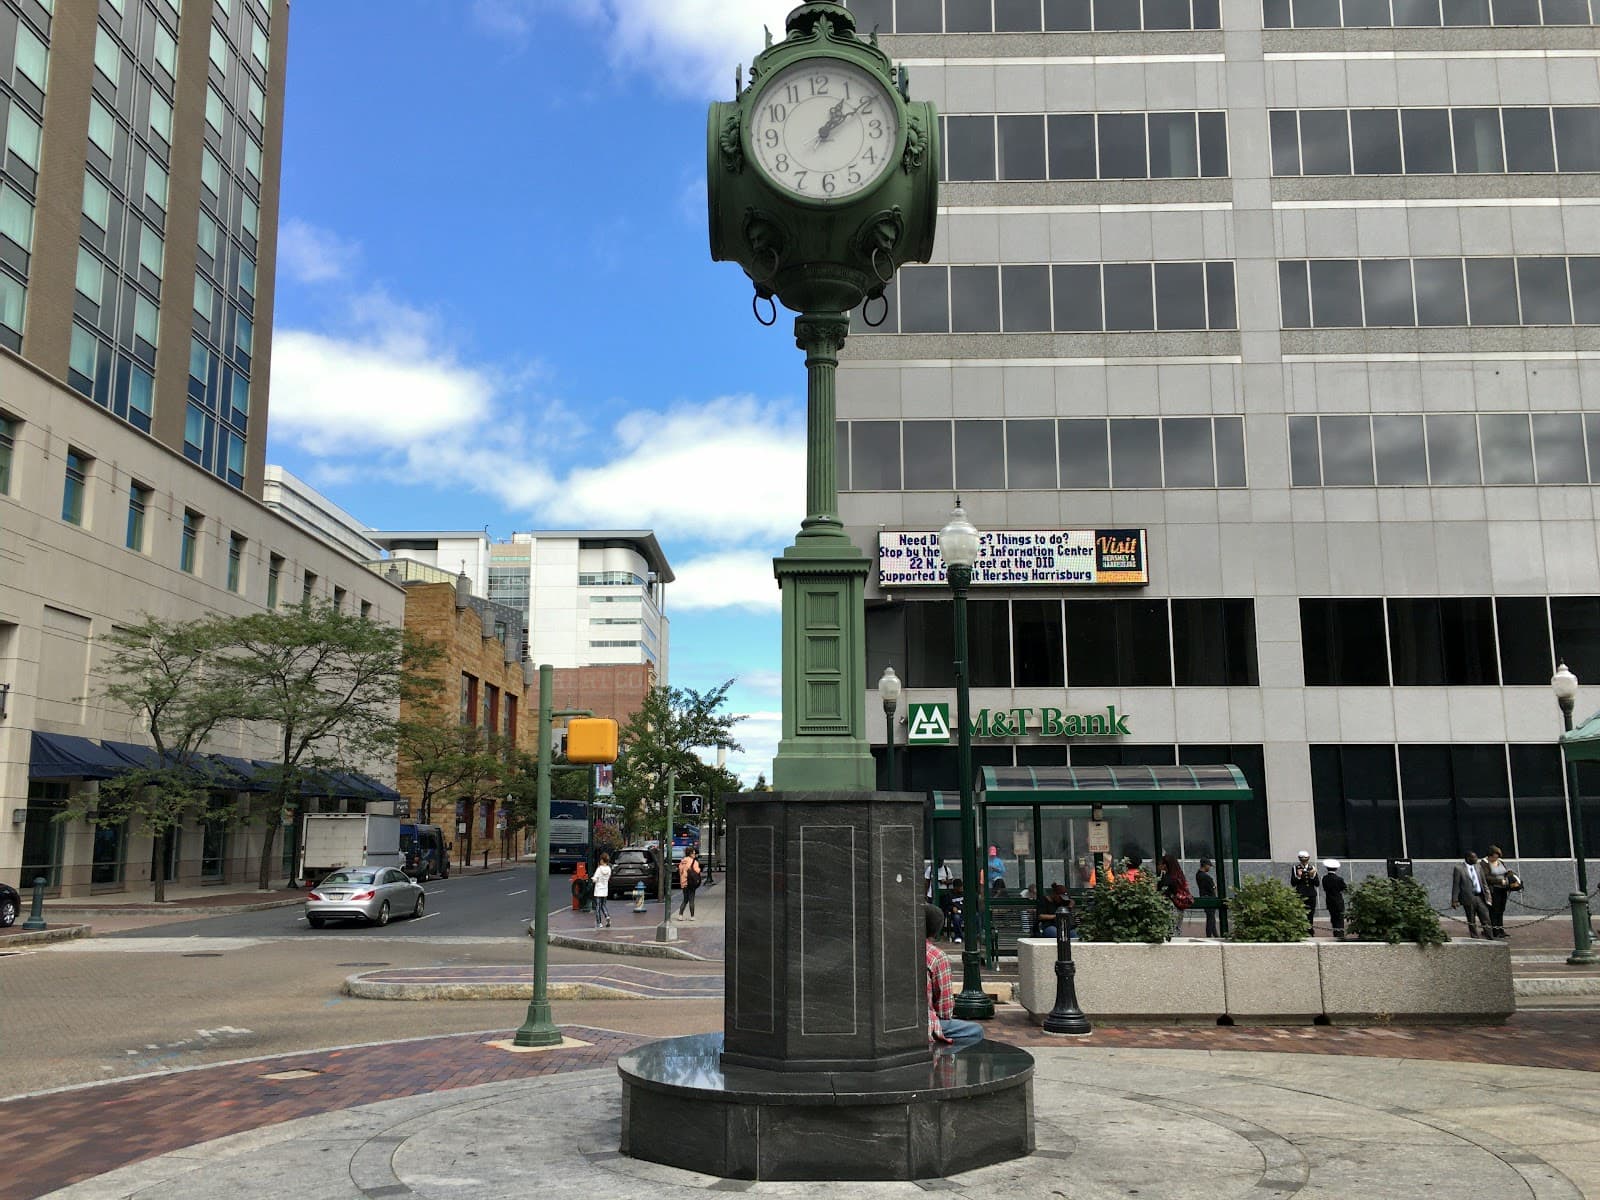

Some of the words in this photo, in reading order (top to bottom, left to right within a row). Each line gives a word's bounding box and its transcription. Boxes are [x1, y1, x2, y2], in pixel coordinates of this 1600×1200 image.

[786, 84, 800, 103] 11
[808, 75, 829, 96] 12
[843, 81, 851, 100] 1
[768, 103, 786, 123] 10
[860, 95, 874, 115] 2
[765, 129, 779, 148] 9
[868, 119, 883, 139] 3
[775, 153, 789, 173] 8
[861, 146, 876, 165] 4
[793, 171, 808, 190] 7
[847, 163, 861, 184] 5
[822, 174, 836, 193] 6
[899, 534, 927, 545] Need
[996, 533, 1032, 545] Things
[1035, 534, 1046, 544] to
[1049, 532, 1069, 544] do?
[1096, 536, 1137, 554] Visit
[879, 546, 902, 557] Stop
[906, 547, 919, 558] by
[922, 546, 940, 557] the
[990, 545, 1054, 556] Information
[1057, 544, 1094, 556] Center
[910, 557, 923, 569] 22
[926, 558, 938, 569] N.
[974, 559, 997, 568] reet
[1000, 558, 1011, 568] at
[1014, 557, 1033, 568] the
[1036, 556, 1055, 568] DID
[879, 570, 935, 582] Supported
[982, 569, 1029, 581] Hershey
[1031, 568, 1092, 581] Harrisburg
[968, 707, 1034, 738] M&T
[1039, 705, 1132, 737] Bank
